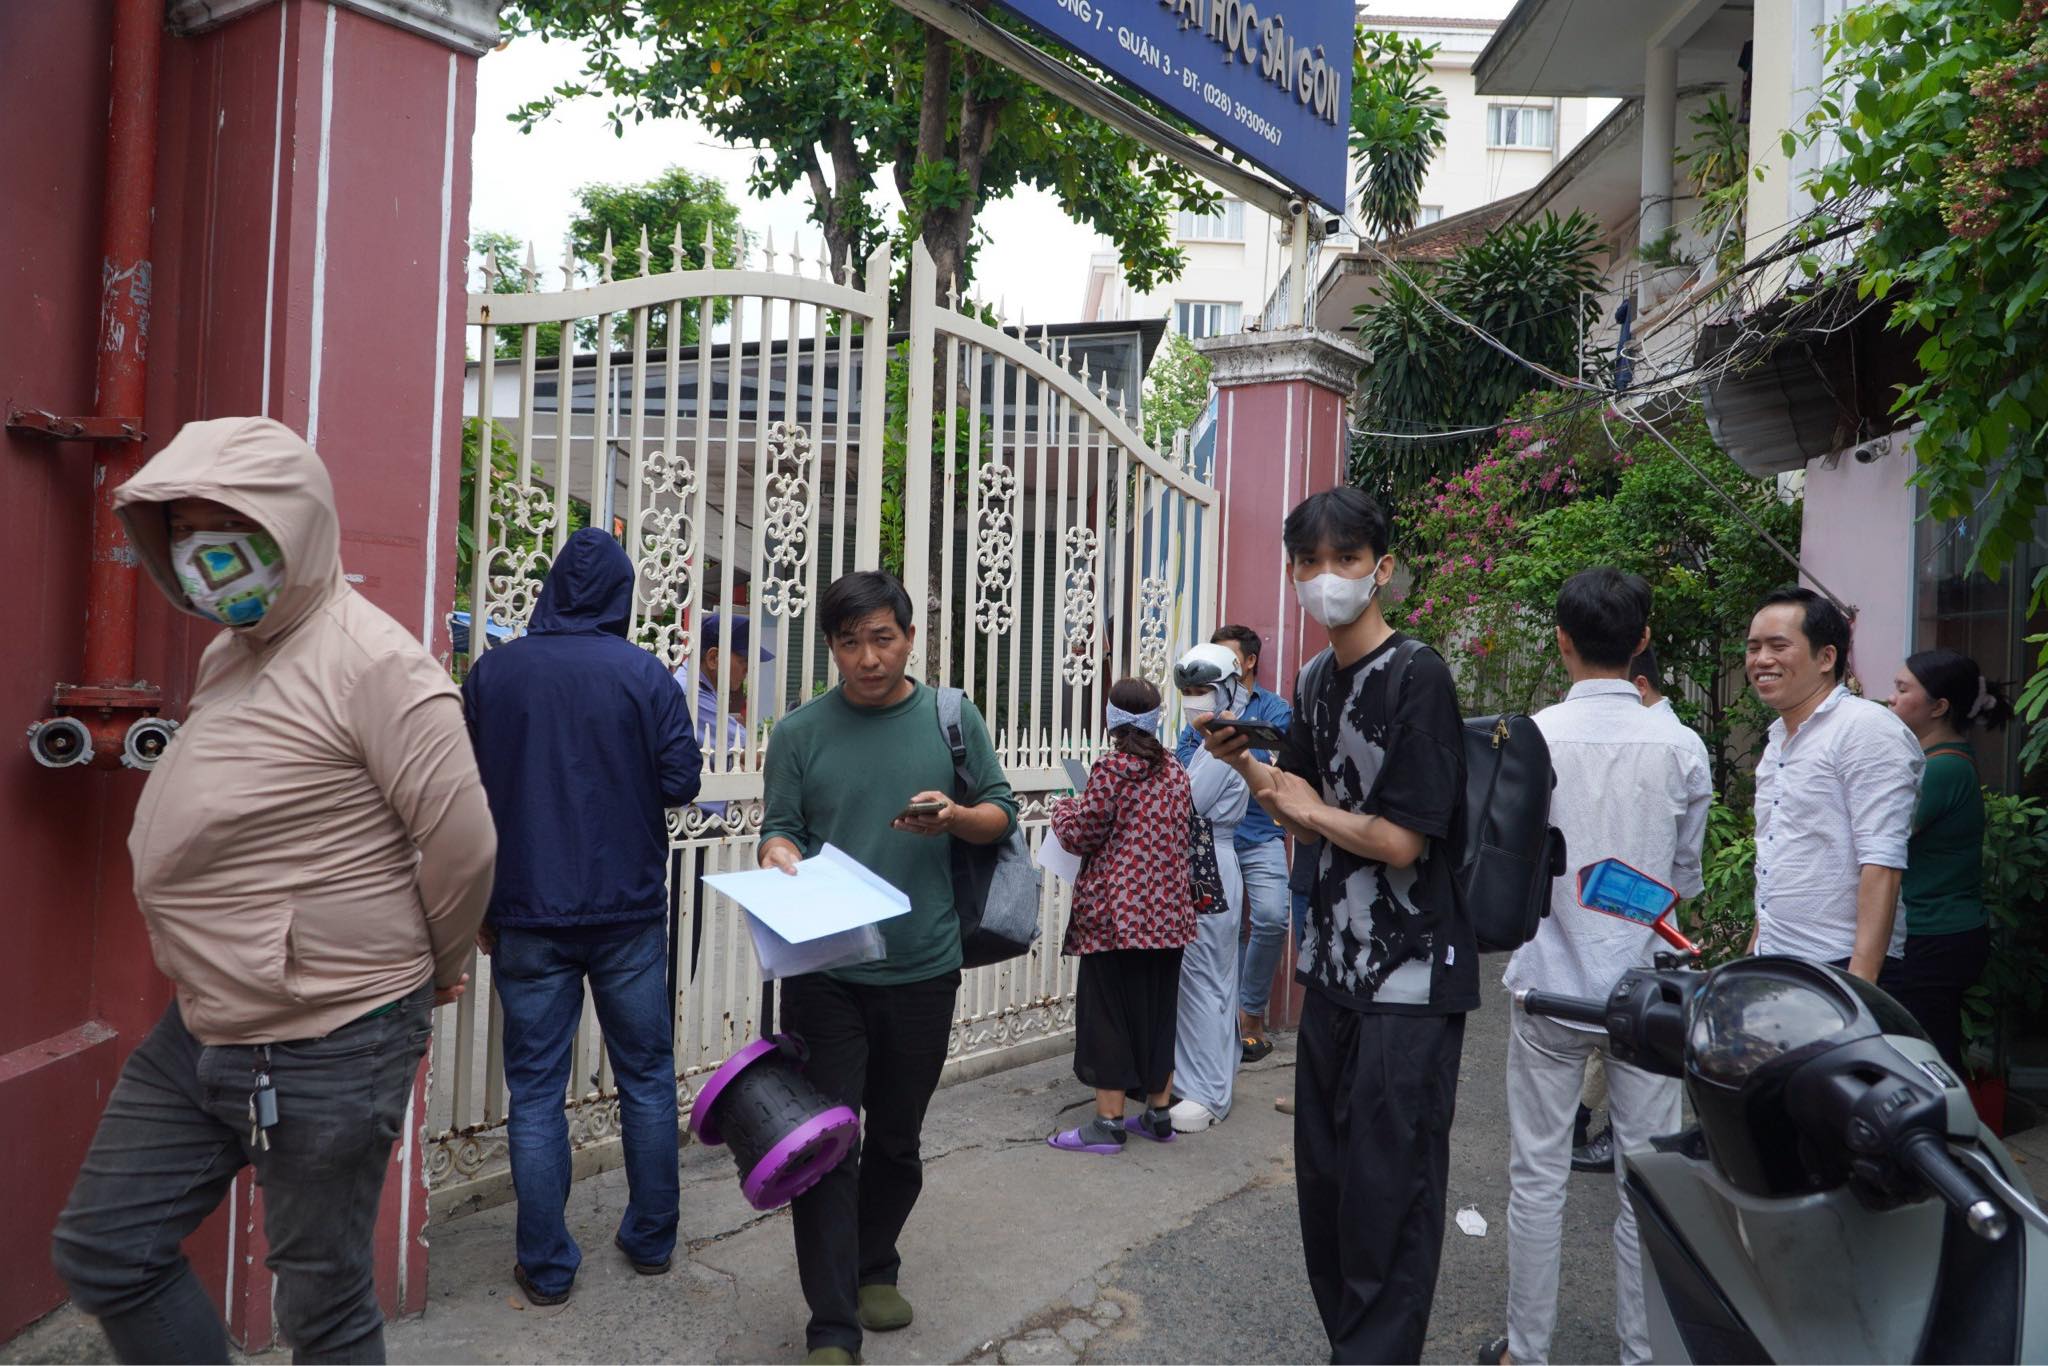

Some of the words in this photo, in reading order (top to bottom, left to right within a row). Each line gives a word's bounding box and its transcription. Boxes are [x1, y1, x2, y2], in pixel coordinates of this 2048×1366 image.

[1095, 8, 1104, 31] 7
[1118, 26, 1160, 69] QUẬN
[1163, 54, 1171, 76] 3
[1183, 66, 1200, 95] ĐT:
[1203, 82, 1232, 117] (028)
[1233, 101, 1282, 146] 39309667
[1209, 0, 1259, 64] HỌC
